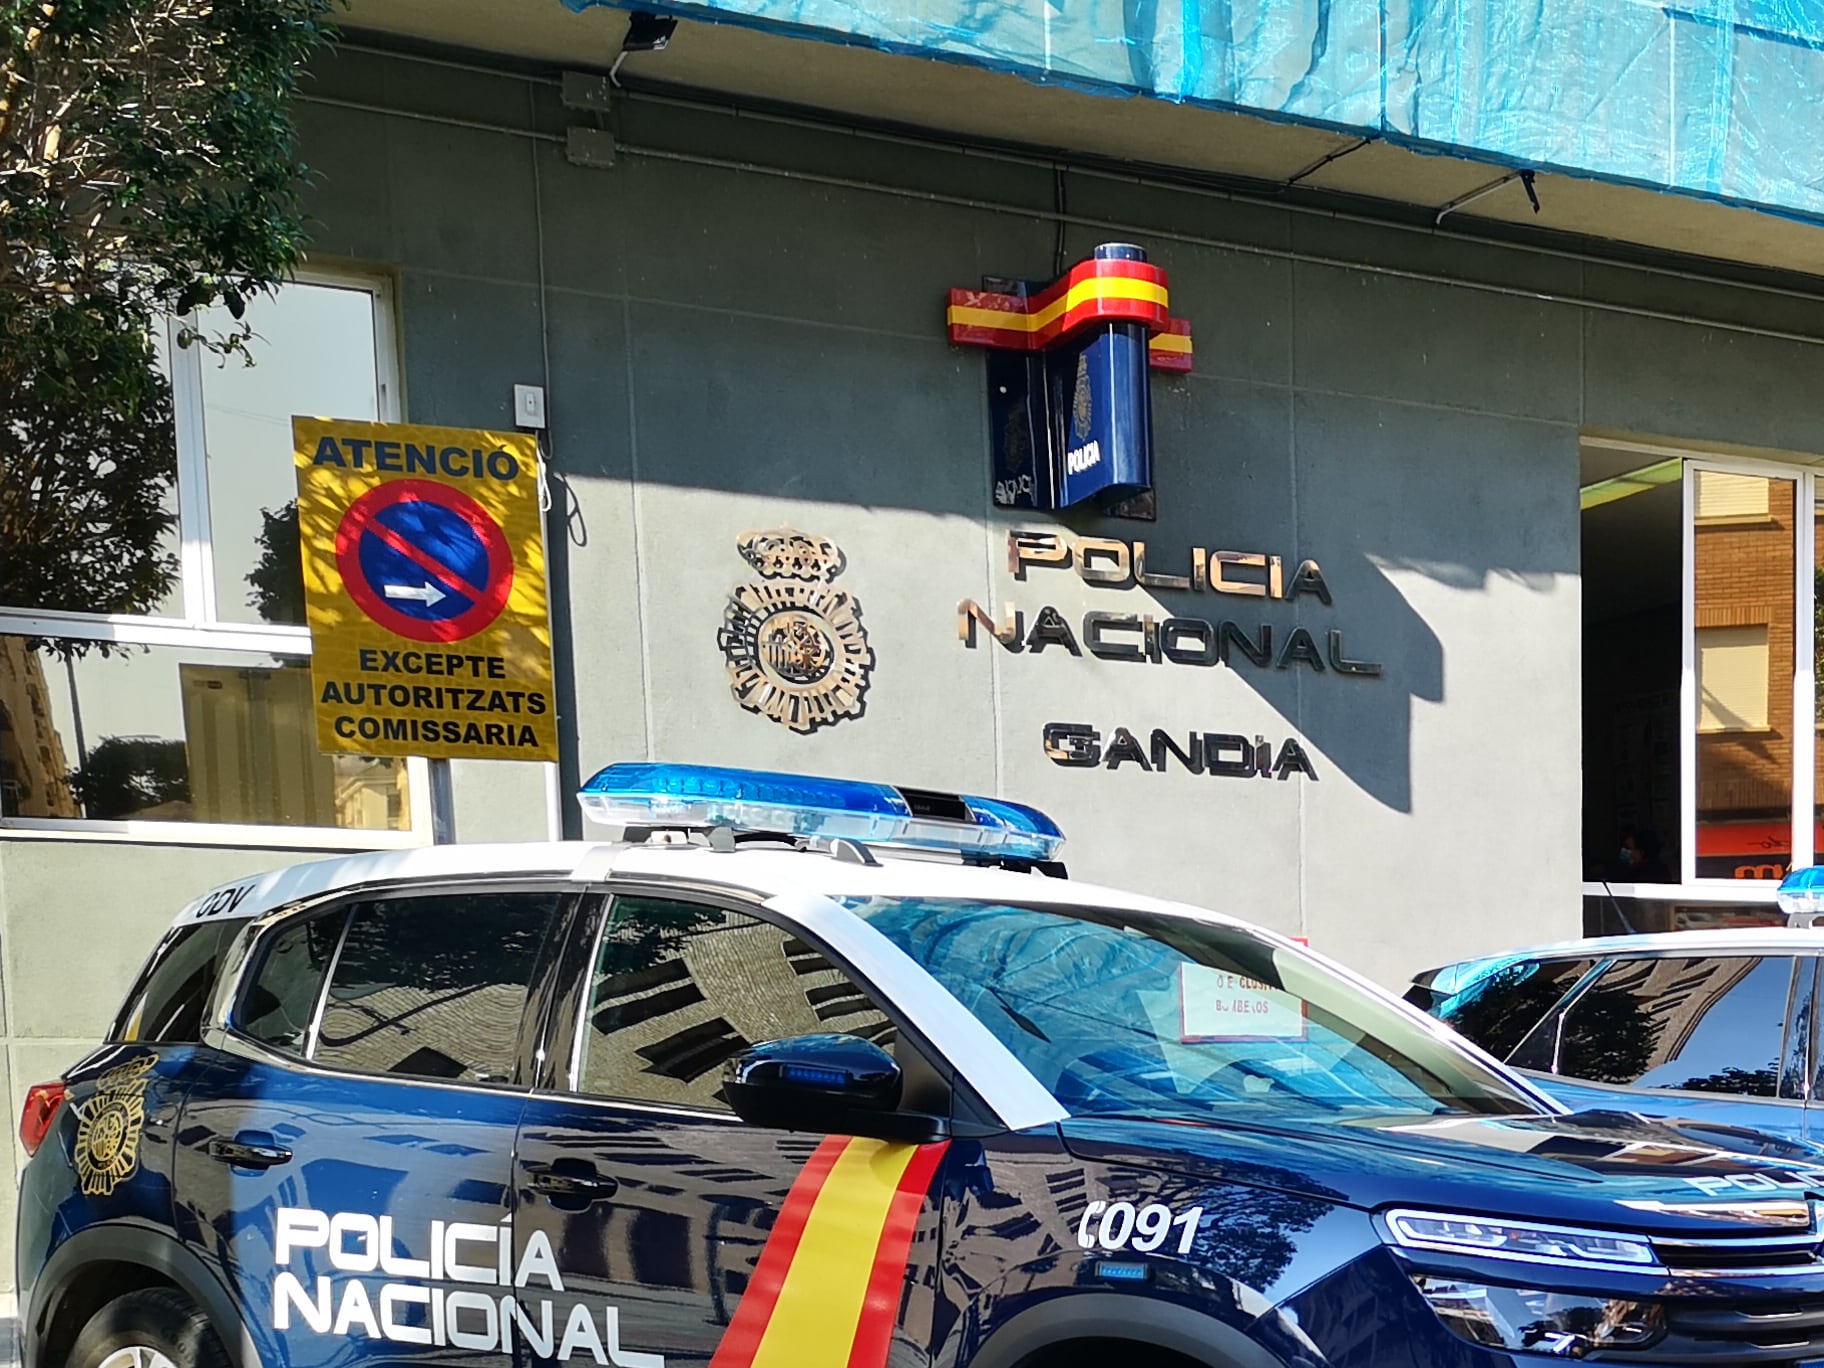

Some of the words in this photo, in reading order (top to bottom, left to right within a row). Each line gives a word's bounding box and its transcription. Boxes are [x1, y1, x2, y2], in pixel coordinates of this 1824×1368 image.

[313, 436, 519, 481] ATENCIÓ
[1007, 529, 1333, 606] POLICIA
[957, 598, 1382, 677] NACIONAL
[360, 649, 506, 679] EXCEPTE
[321, 681, 546, 715] AUTORITZATS
[334, 716, 539, 748] COMISSARIA
[1043, 722, 1318, 781] GANDIA
